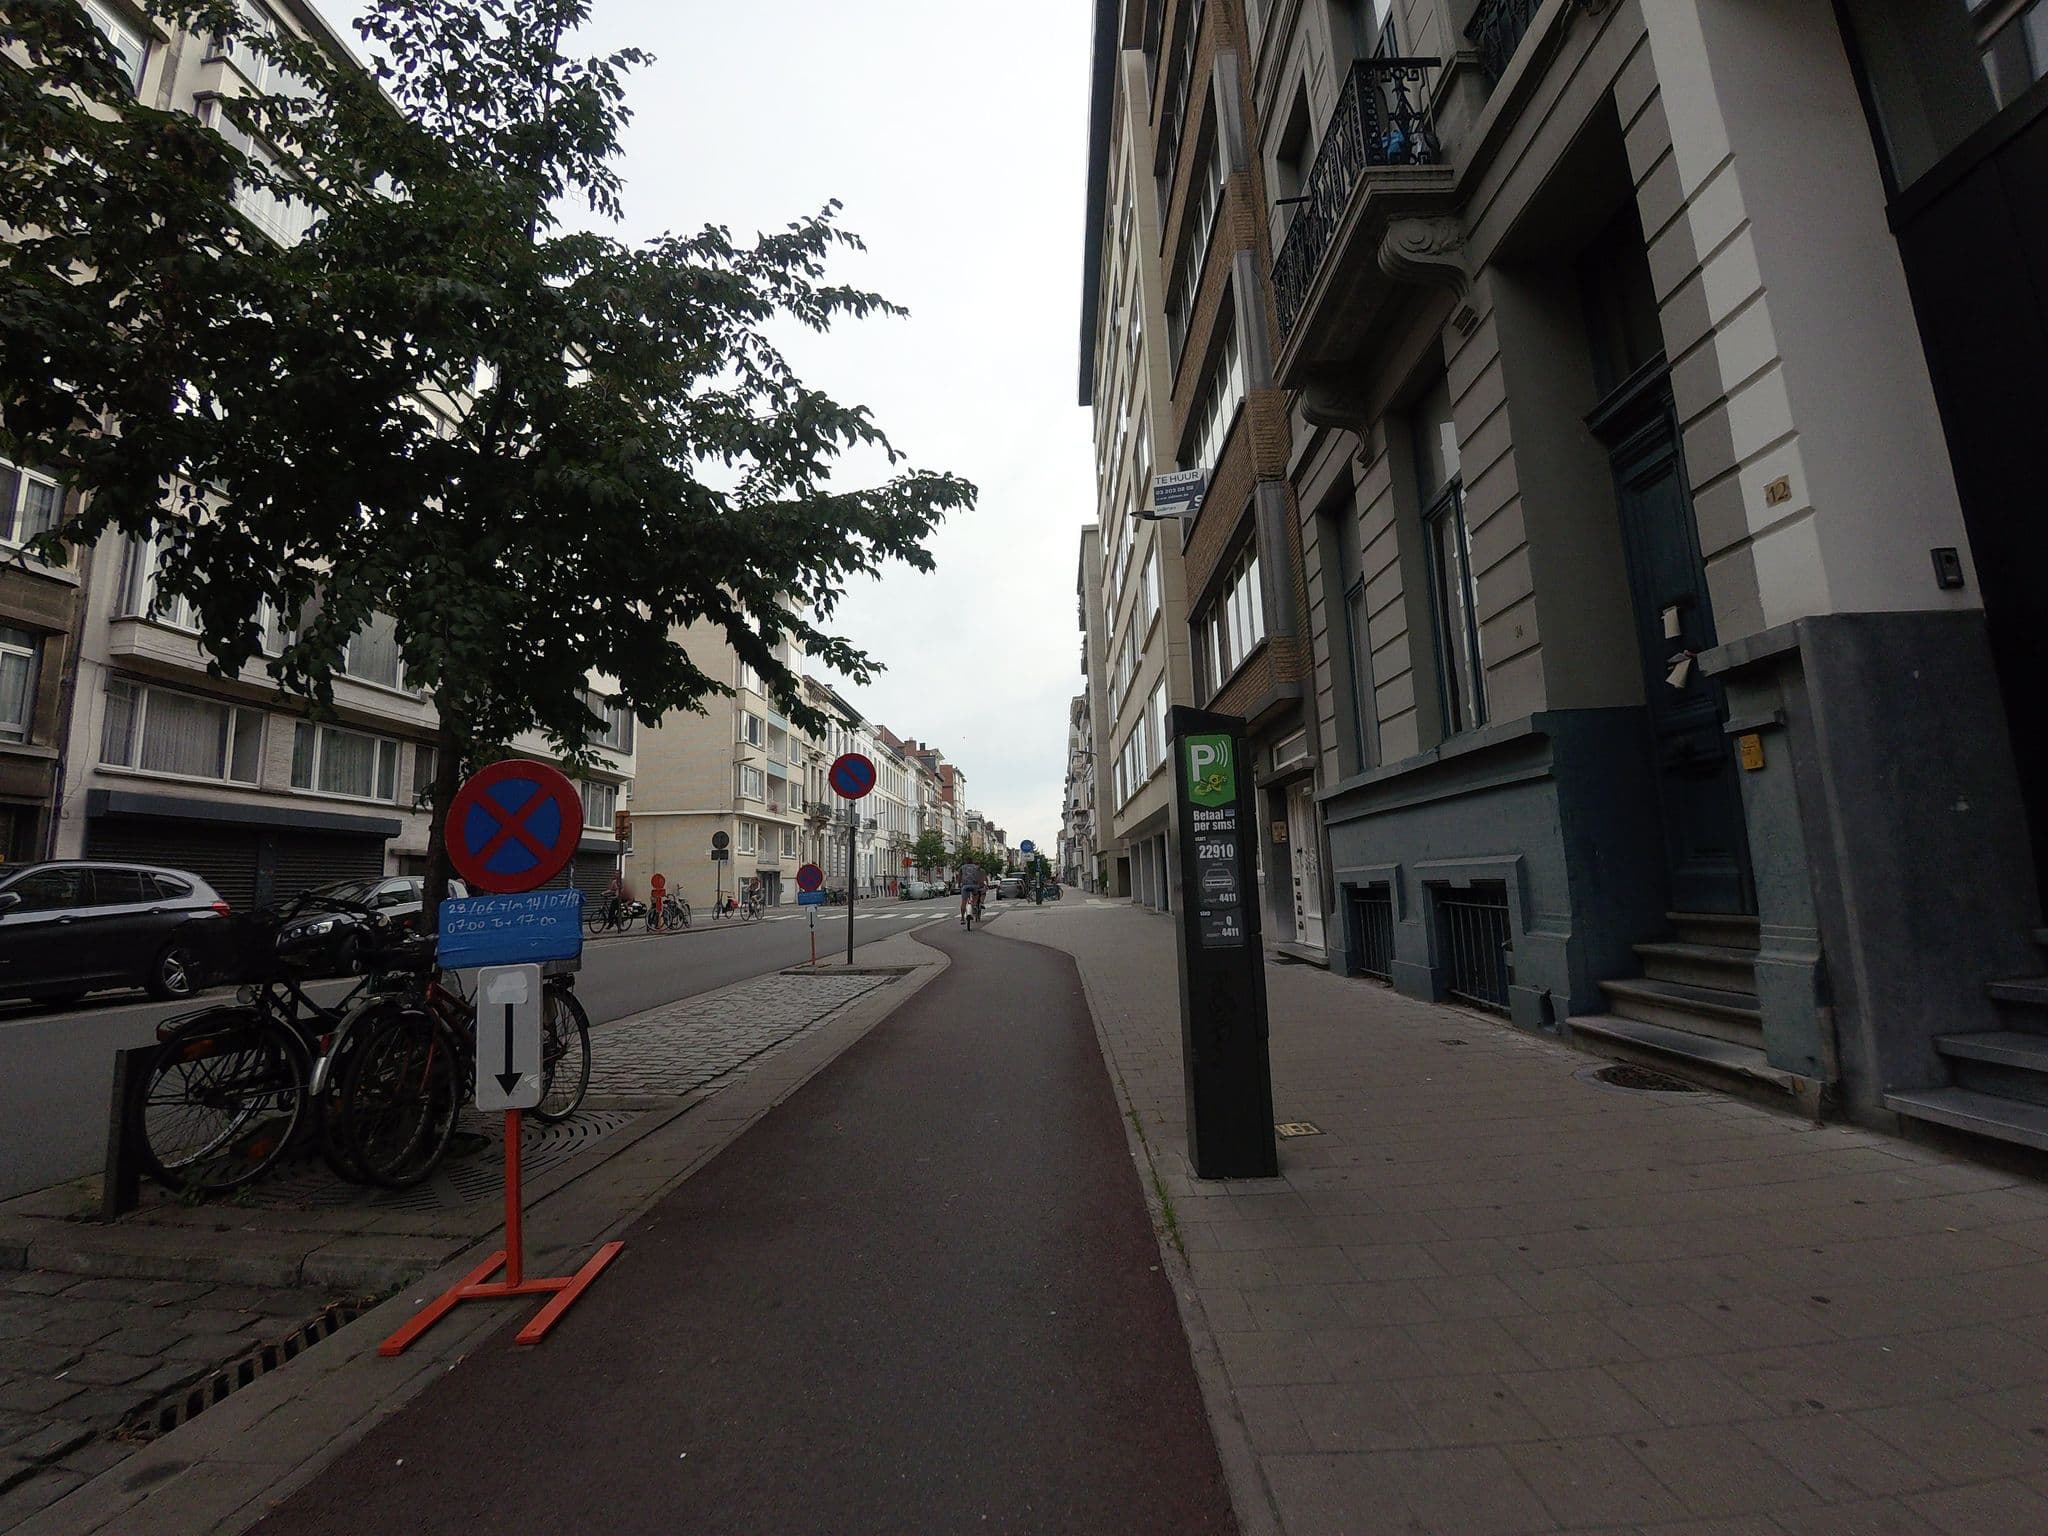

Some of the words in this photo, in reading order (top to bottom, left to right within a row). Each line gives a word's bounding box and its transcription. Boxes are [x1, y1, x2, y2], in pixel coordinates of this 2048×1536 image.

[1155, 477, 1168, 485] TE
[1170, 471, 1199, 483] HUUR
[1769, 481, 1788, 503] 12
[1191, 744, 1216, 782] P
[1193, 809, 1224, 821] Betaal
[1194, 822, 1210, 832] per
[1212, 819, 1235, 831] sms!
[1199, 844, 1234, 859] 22910
[1219, 893, 1237, 902] 4411
[1226, 916, 1232, 926] Q
[1221, 928, 1240, 937] 4411
